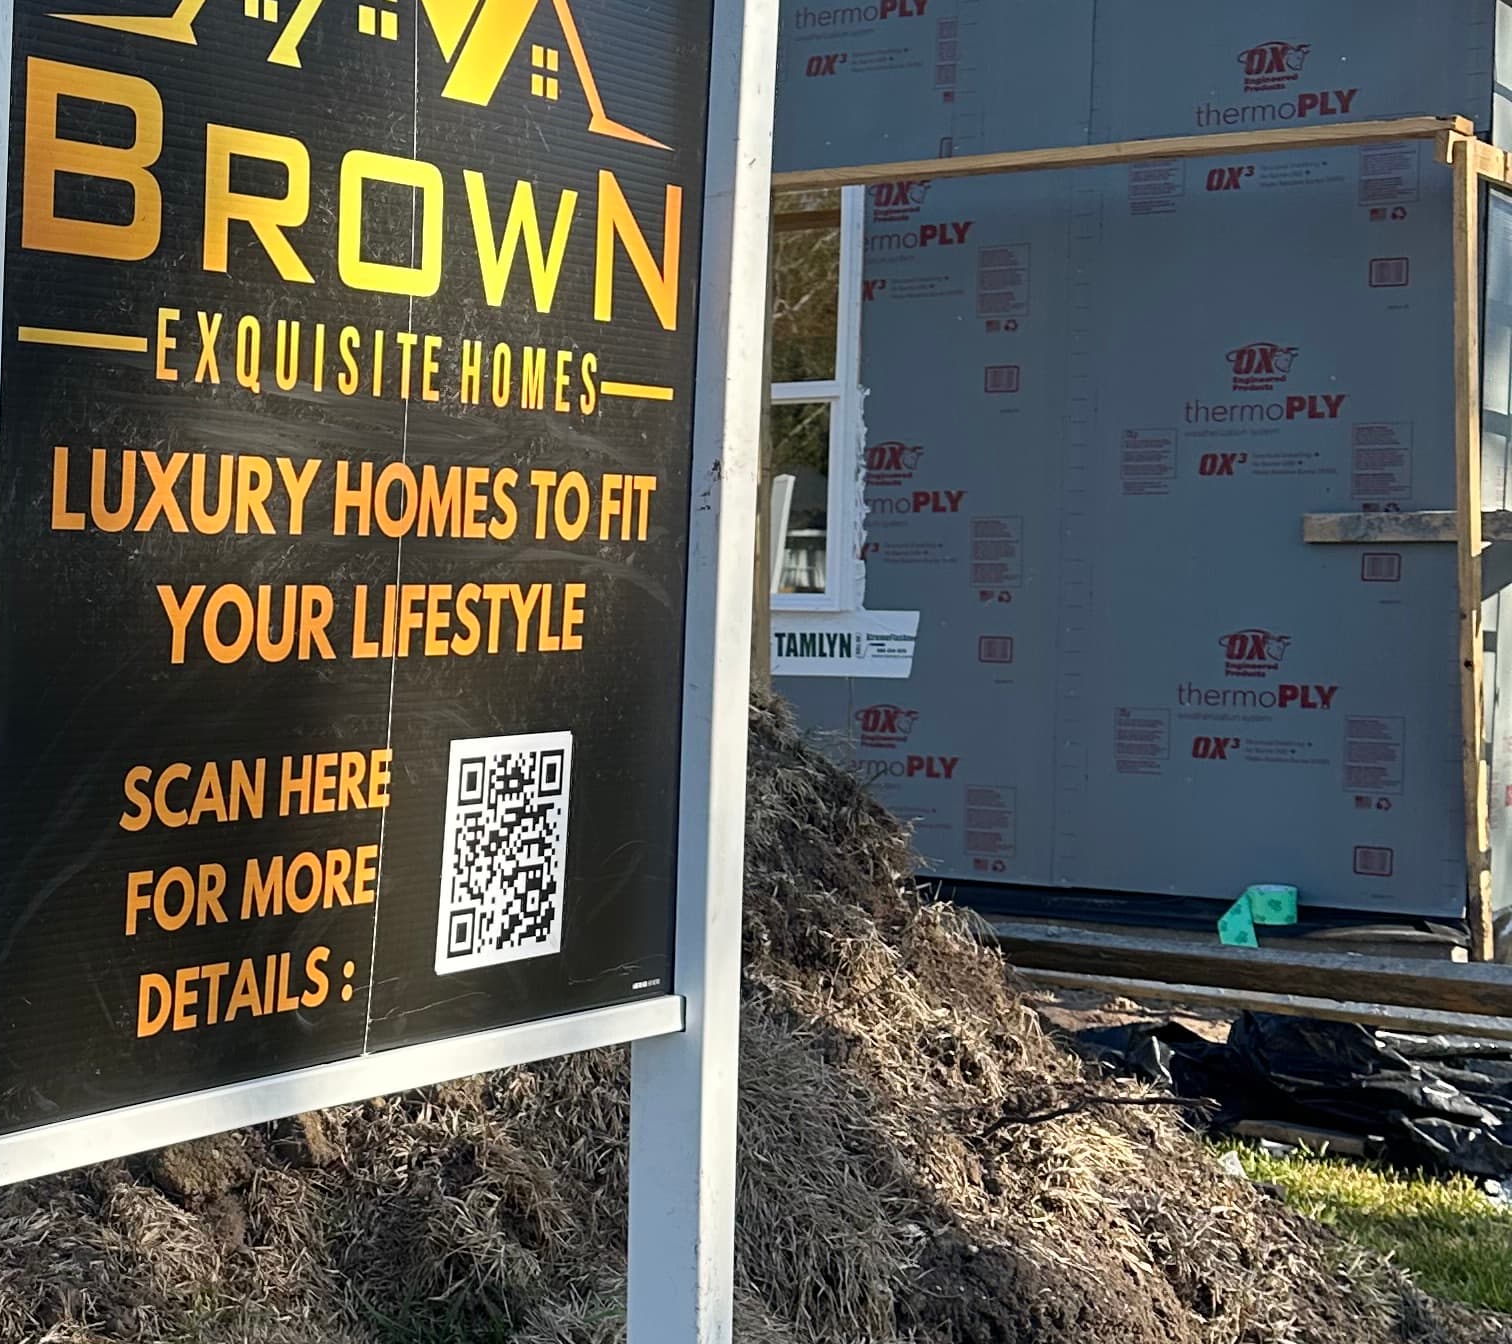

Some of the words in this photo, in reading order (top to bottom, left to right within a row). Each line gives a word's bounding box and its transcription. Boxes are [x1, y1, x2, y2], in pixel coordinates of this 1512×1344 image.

[1243, 46, 1288, 75] OX
[1195, 88, 1357, 127] thermoPLY
[22, 55, 682, 332] BROWN
[156, 308, 443, 403] EXQUISITE
[462, 342, 598, 415] HOMES
[1233, 347, 1277, 375] OX
[1184, 394, 1346, 424] thermoPLY
[51, 446, 322, 536] LUXURY
[333, 460, 519, 541] HOMES
[529, 470, 590, 541] TO
[599, 474, 657, 542] FIT
[157, 583, 337, 665] YOUR
[351, 582, 587, 659] LIFESTYLE
[774, 632, 852, 658] TAMLYN
[1225, 633, 1269, 661] OX
[1178, 682, 1339, 710] thermoPLY
[119, 758, 266, 832] SCAN
[280, 747, 393, 816] HERE
[125, 864, 228, 936] FOR
[241, 844, 379, 919] MORE
